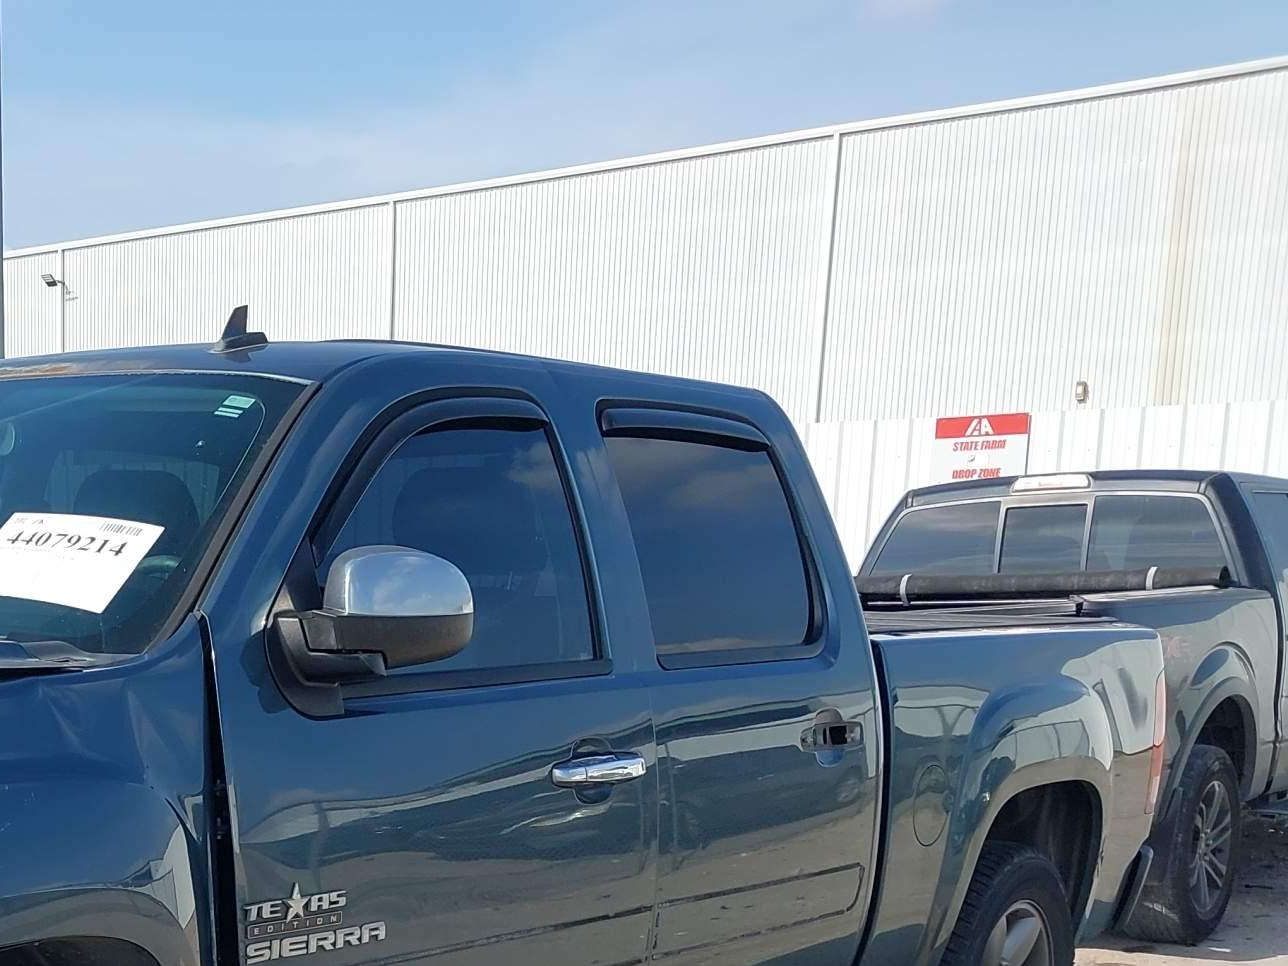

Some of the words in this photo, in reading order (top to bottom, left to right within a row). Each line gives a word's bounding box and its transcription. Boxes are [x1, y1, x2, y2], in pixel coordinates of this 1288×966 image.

[952, 440, 979, 452] STATE
[980, 439, 1007, 450] FARM
[952, 469, 978, 480] DROP
[978, 467, 1002, 478] ZONE
[6, 529, 128, 556] 44079214
[244, 882, 348, 922] TEXAS
[253, 914, 339, 935] EDITION
[246, 920, 387, 965] SIERRA
